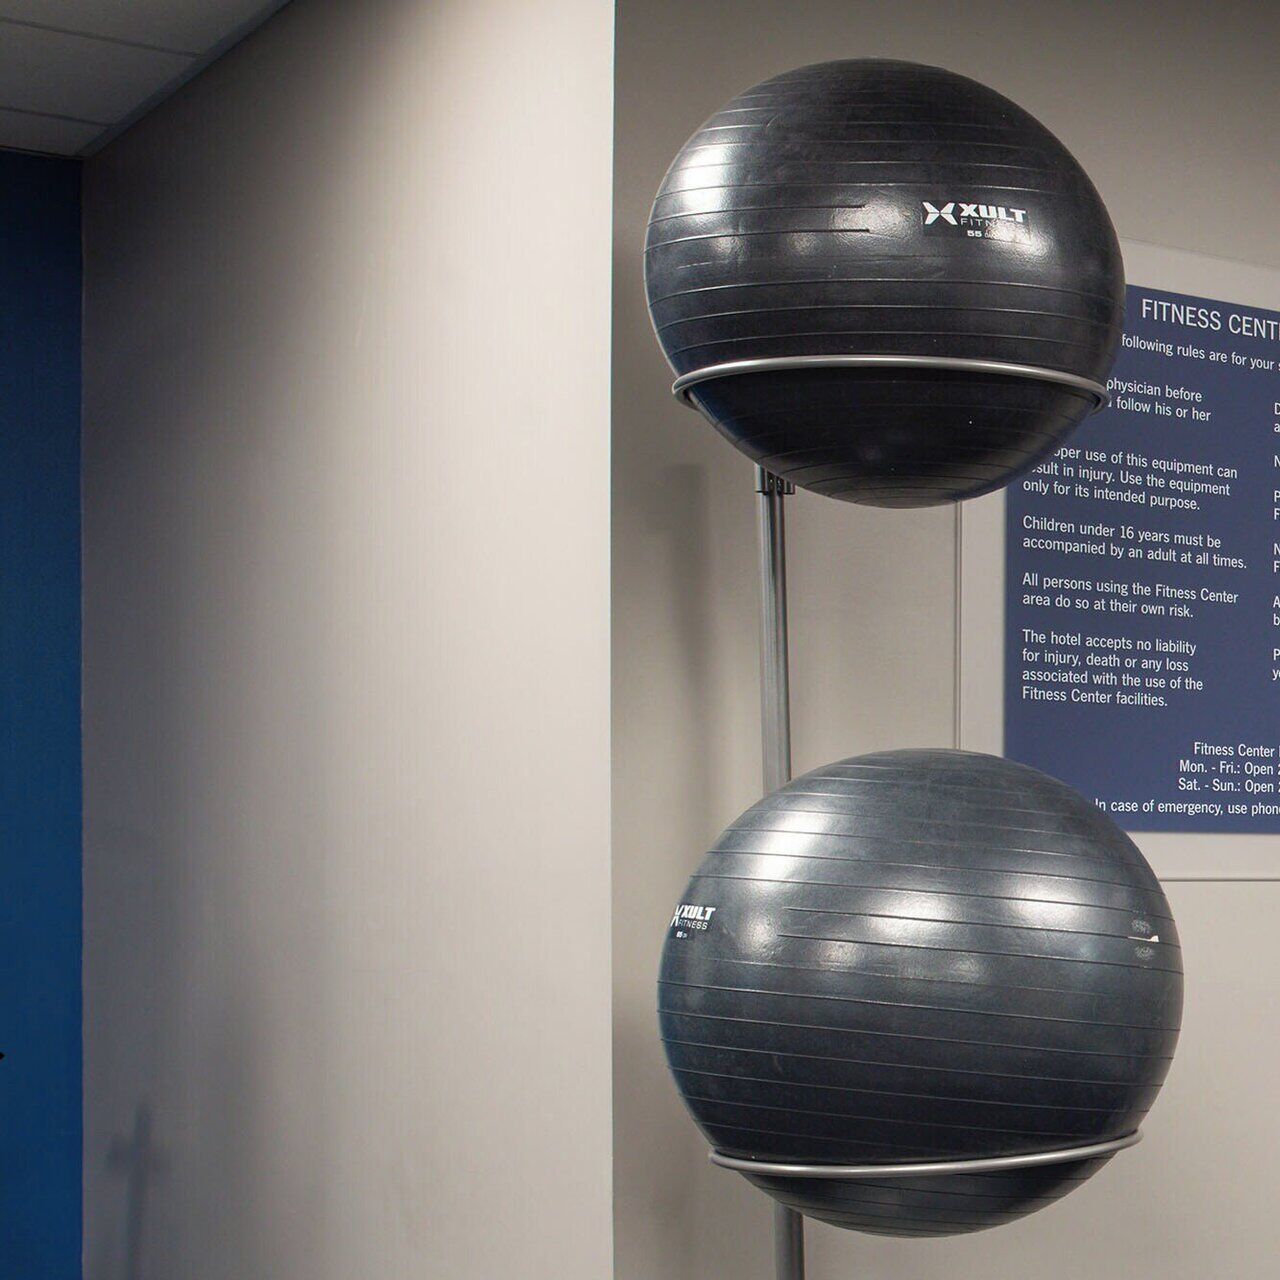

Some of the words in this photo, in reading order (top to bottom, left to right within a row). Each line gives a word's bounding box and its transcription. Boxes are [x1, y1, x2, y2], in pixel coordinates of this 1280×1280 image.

[958, 203, 1027, 223] XULT
[967, 229, 982, 238] 55
[1142, 299, 1221, 330] FITNESS
[1122, 334, 1173, 356] following
[1177, 345, 1205, 359] rules
[1209, 351, 1227, 363] are
[1231, 352, 1247, 365] for
[1250, 358, 1275, 370] your
[1106, 377, 1161, 396] physician
[1166, 385, 1202, 402] before
[1116, 396, 1151, 413] follow
[1155, 401, 1172, 416] his
[1176, 408, 1188, 418] or
[1192, 407, 1211, 421] her
[1086, 451, 1106, 462] use
[1111, 451, 1123, 464] of
[1126, 453, 1148, 467] this
[1152, 459, 1213, 476] equipment
[1217, 467, 1237, 479] can
[1063, 463, 1074, 477] in
[1079, 466, 1115, 484] injury.
[1120, 470, 1142, 485] Use
[1146, 474, 1165, 488] the
[1169, 479, 1230, 496] equipment
[1023, 479, 1049, 495] only
[1053, 481, 1071, 495] for
[1075, 484, 1089, 497] its
[1094, 486, 1145, 503] intended
[1150, 495, 1200, 510] purpose.
[1023, 515, 1074, 533] Children
[1080, 523, 1115, 537] under
[1121, 526, 1134, 539] 16
[1138, 531, 1170, 543] years
[1174, 535, 1203, 547] must
[1207, 535, 1221, 548] be
[1023, 538, 1105, 555] accompanied
[1110, 543, 1124, 559] by
[1128, 548, 1142, 558] an
[1147, 548, 1176, 562] adult
[1180, 551, 1192, 563] at
[1196, 552, 1209, 565] all
[1213, 554, 1247, 568] times.
[1022, 572, 1038, 586] All
[1043, 577, 1092, 591] persons
[1097, 580, 1128, 596] using
[1132, 582, 1151, 596] the
[1156, 584, 1196, 600] Fitness
[1200, 588, 1239, 603] Center
[1022, 629, 1046, 643] The
[1051, 631, 1081, 645] hotel
[1085, 637, 1132, 651] accepts
[1137, 641, 1151, 651] no
[1156, 639, 1196, 656] liability
[1023, 686, 1067, 701] Fitness
[1071, 688, 1112, 703] Center
[1116, 691, 1167, 706] facilities.
[1194, 742, 1234, 756] Fitness
[1238, 743, 1275, 757] Center
[1180, 759, 1207, 773] Mon.
[1220, 761, 1240, 774] Fri.:
[1244, 761, 1273, 777] Open
[1111, 802, 1138, 812] case
[1142, 799, 1154, 812] of
[1158, 803, 1223, 816] emergency,
[1228, 804, 1247, 814] use
[680, 905, 716, 921] XULT
